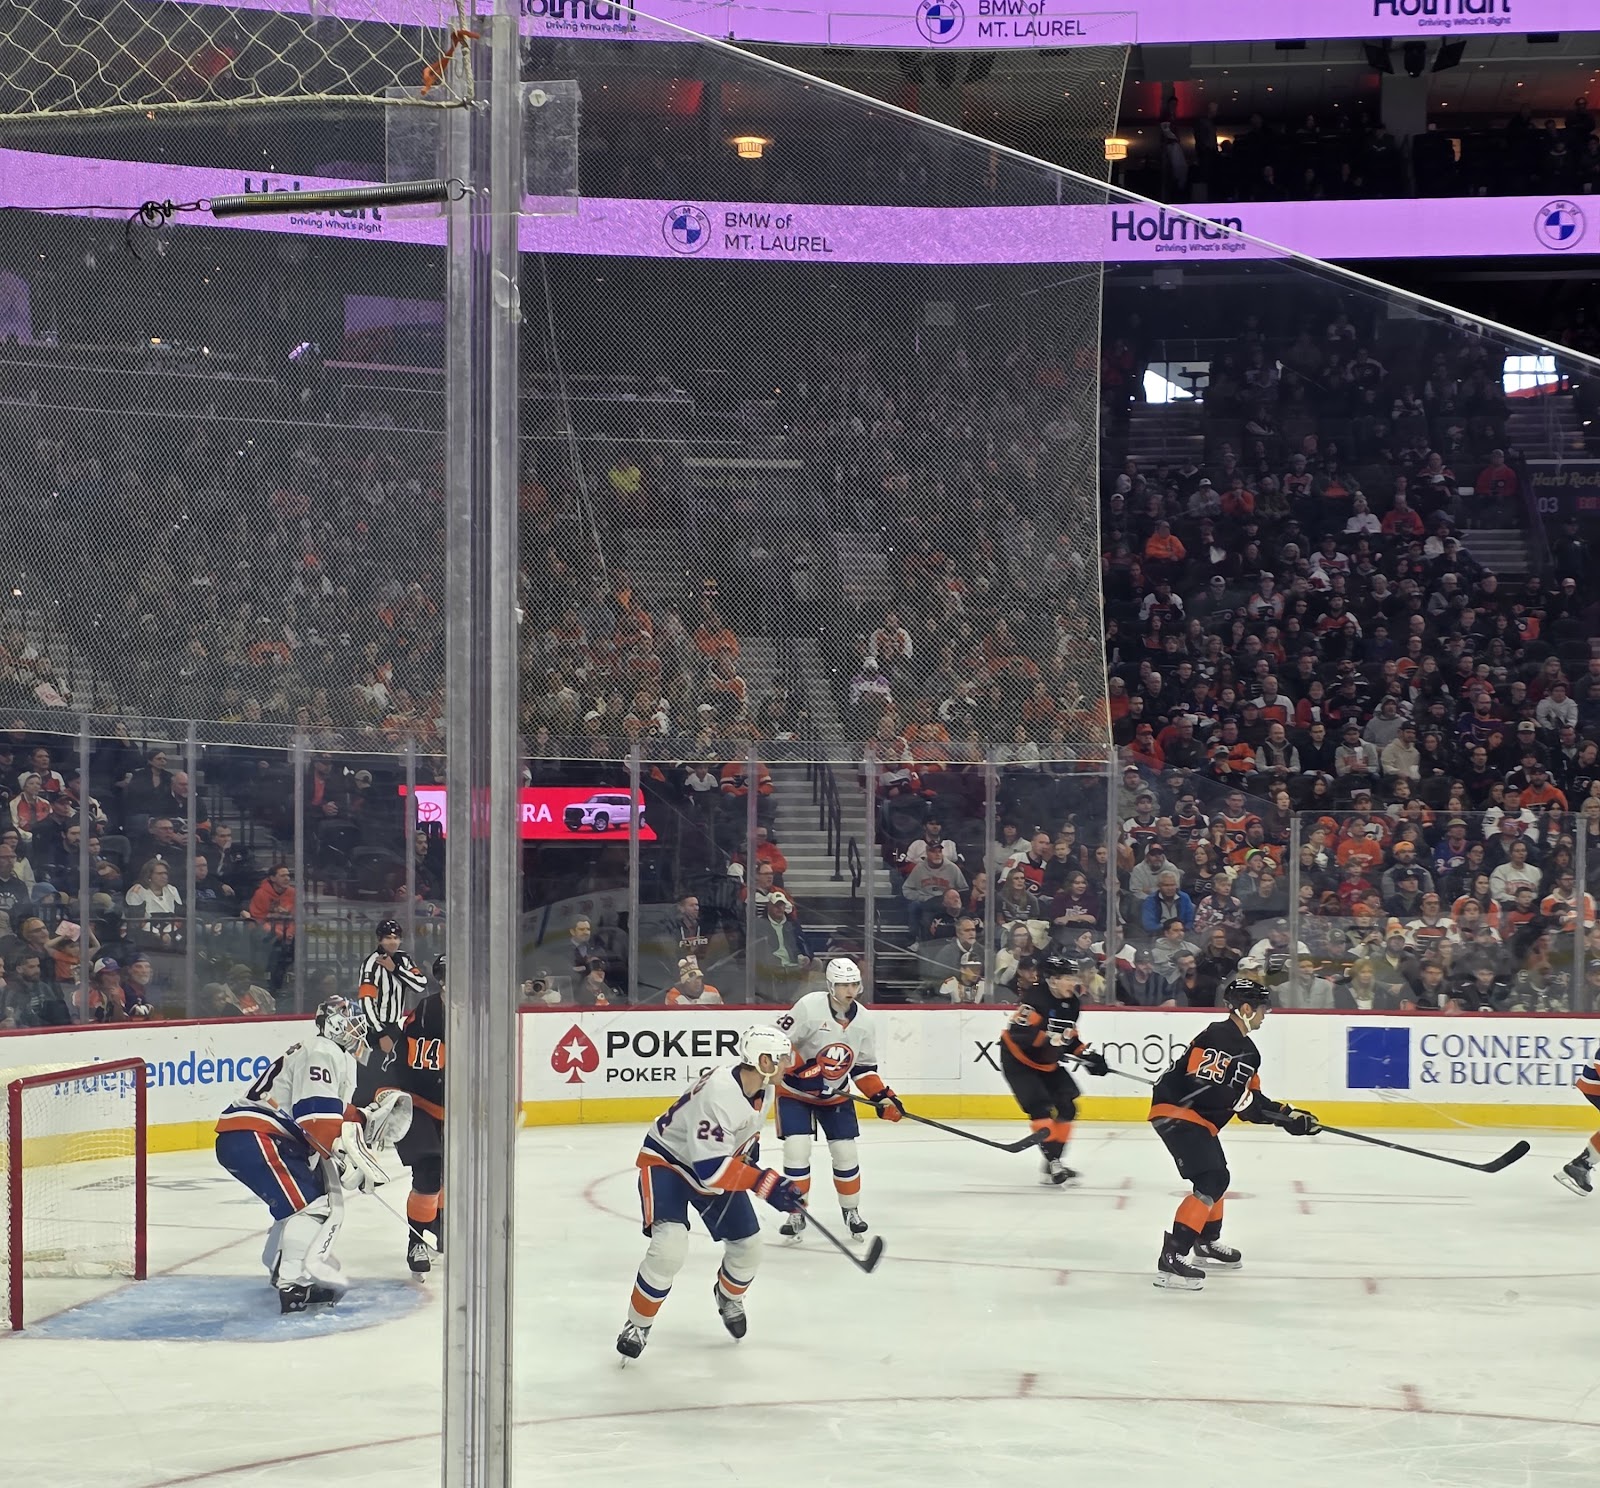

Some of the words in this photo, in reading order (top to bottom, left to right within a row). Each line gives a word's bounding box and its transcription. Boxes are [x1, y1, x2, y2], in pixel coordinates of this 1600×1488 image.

[520, 0, 636, 20] olman
[979, 0, 1022, 15] BMW
[1029, 0, 1046, 15] of
[978, 22, 1008, 37] MT.
[1014, 20, 1087, 37] LAUREL
[290, 216, 323, 230] Driving
[359, 222, 382, 234] Right
[725, 212, 770, 228] BMW
[776, 213, 792, 229] of
[1112, 207, 1242, 241] Holman
[725, 234, 754, 250] MT.
[761, 235, 833, 252] LAUREL
[412, 1037, 441, 1070] 14
[606, 1030, 741, 1058] POKER
[1102, 1034, 1189, 1072] mob
[1420, 1034, 1553, 1059] CONNER
[1559, 1036, 1600, 1060] ST
[309, 1066, 332, 1084] 50
[606, 1066, 677, 1082] POKER
[1196, 1047, 1232, 1084] 25
[1420, 1060, 1442, 1084] &
[697, 1120, 724, 1142] 24
